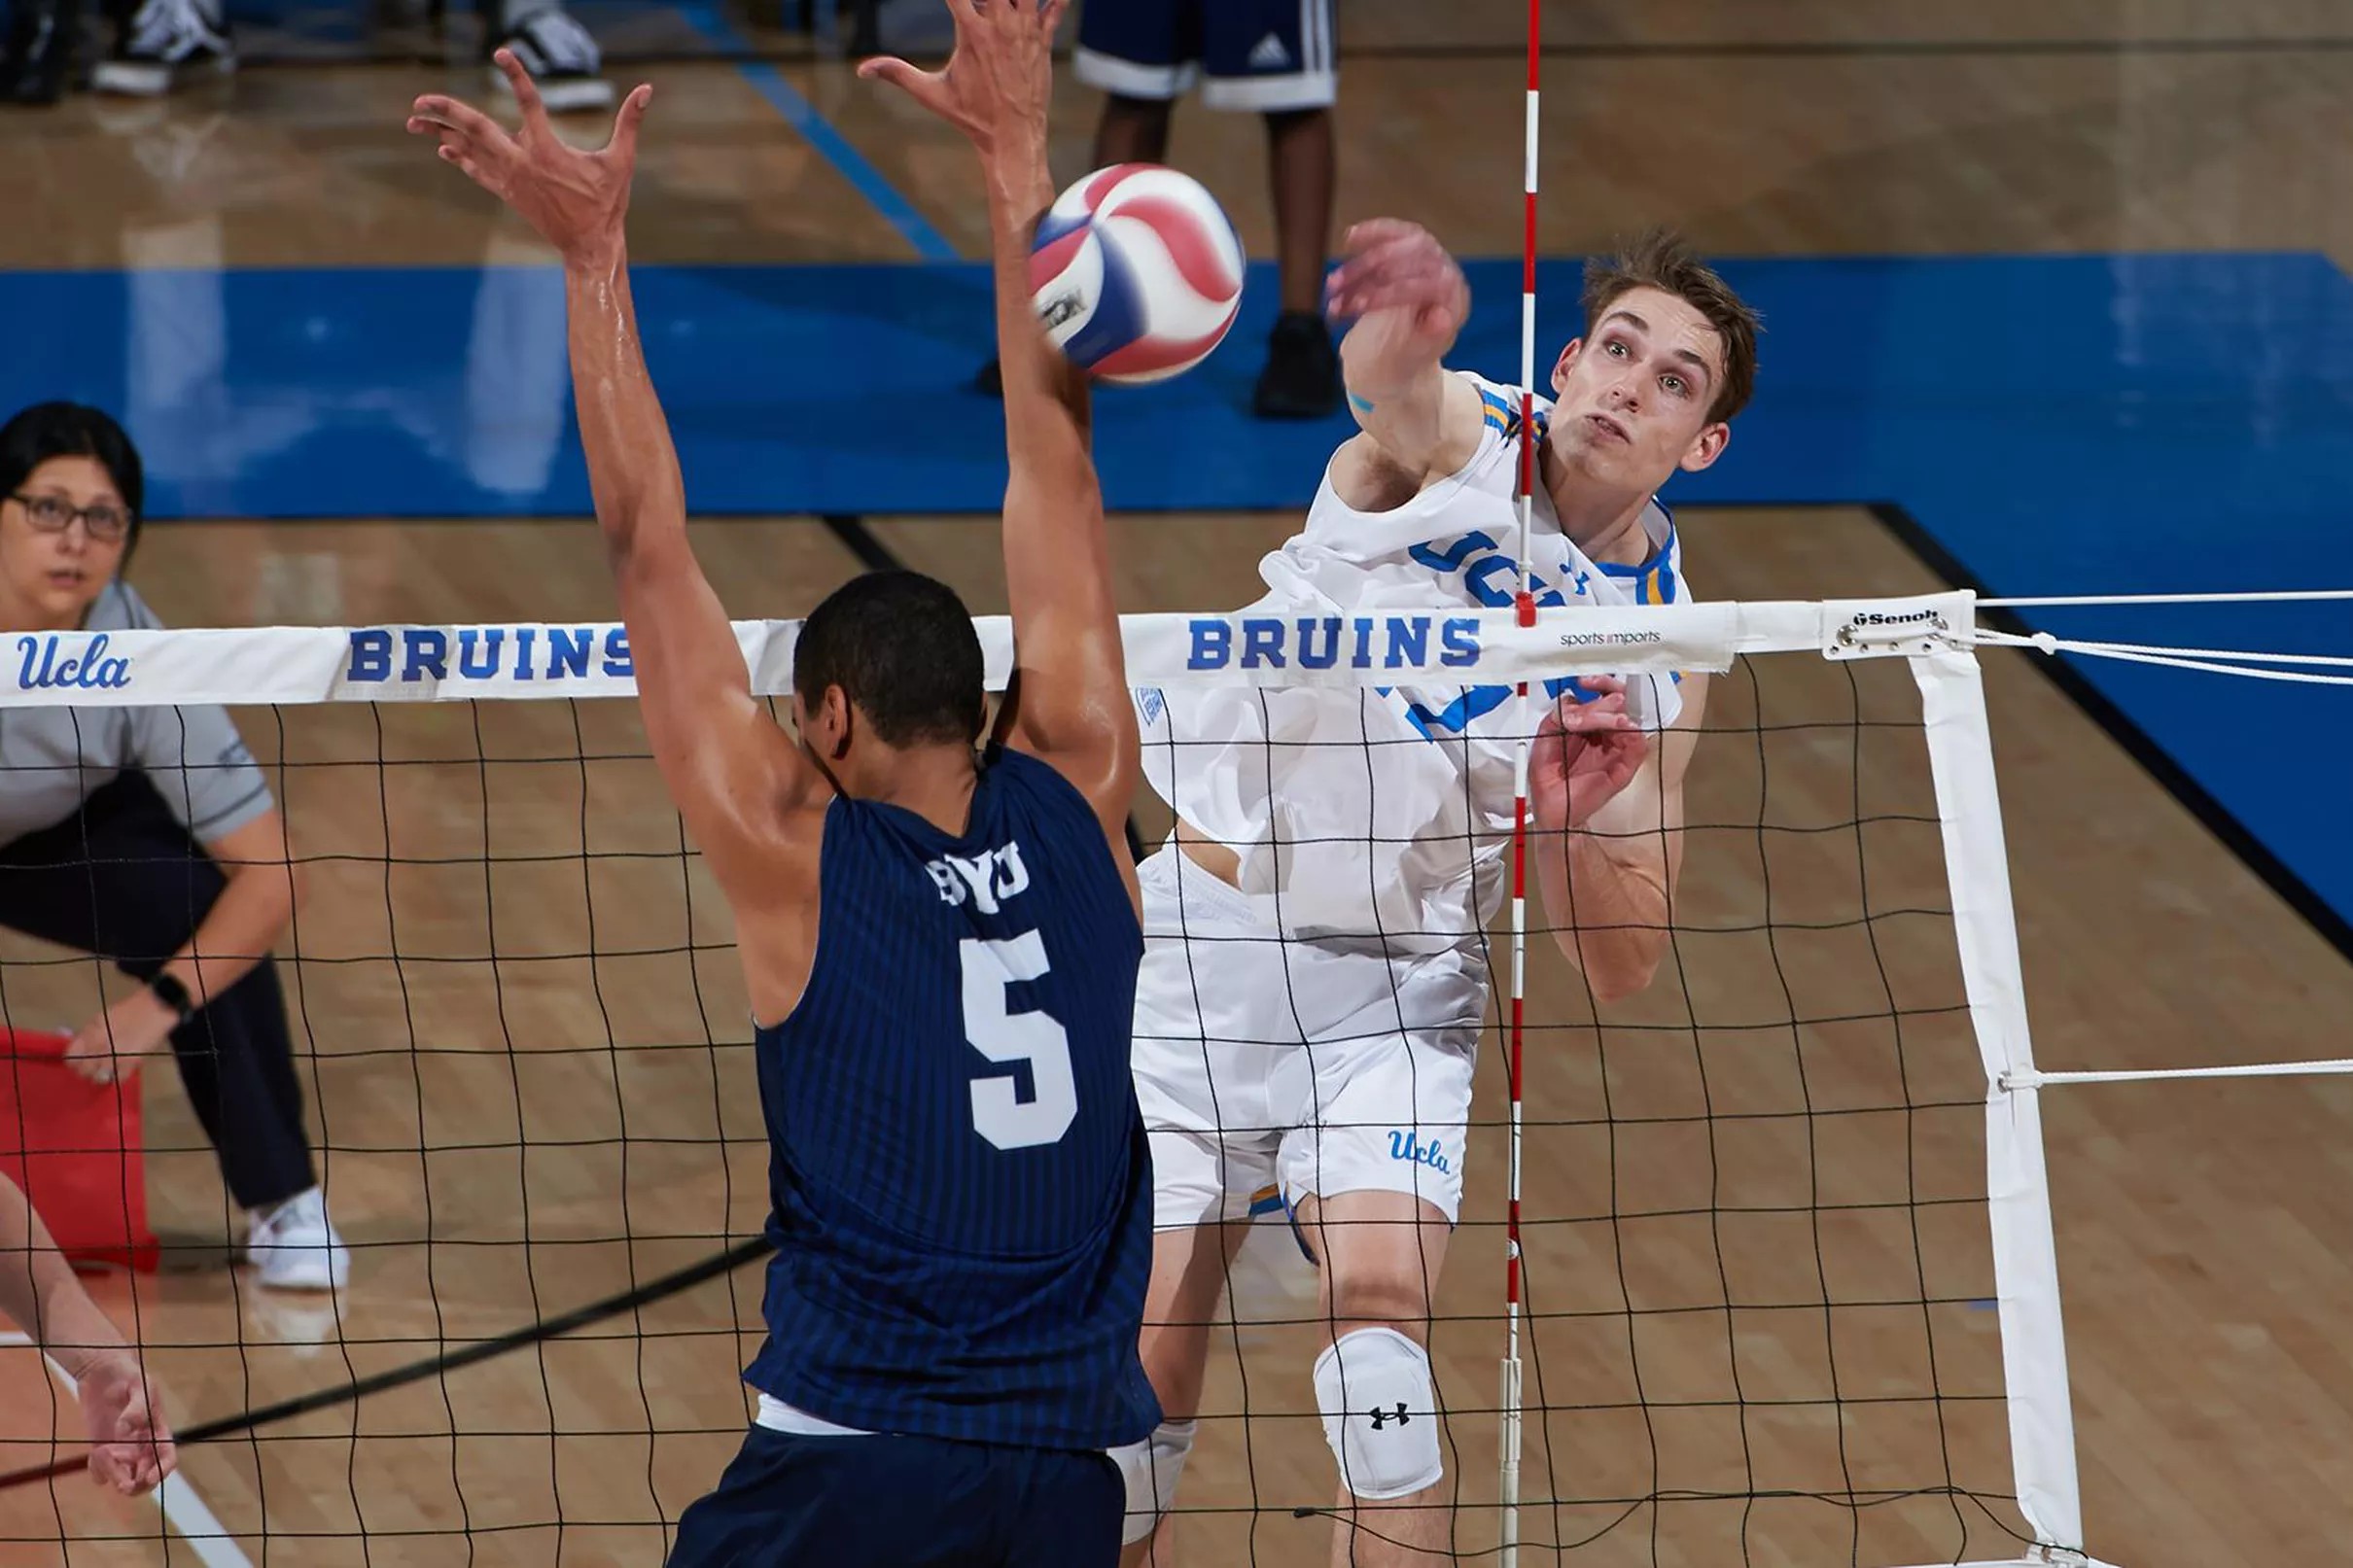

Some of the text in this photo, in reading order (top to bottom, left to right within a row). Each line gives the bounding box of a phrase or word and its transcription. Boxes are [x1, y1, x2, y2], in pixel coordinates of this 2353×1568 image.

[17, 634, 131, 690] Ucla
[346, 628, 635, 681] BRUINS
[1187, 616, 1482, 670] BRUINS
[1560, 632, 1605, 647] sports
[925, 840, 1030, 915] BYU
[959, 927, 1078, 1151] 5
[1387, 1130, 1451, 1175] Ucla
